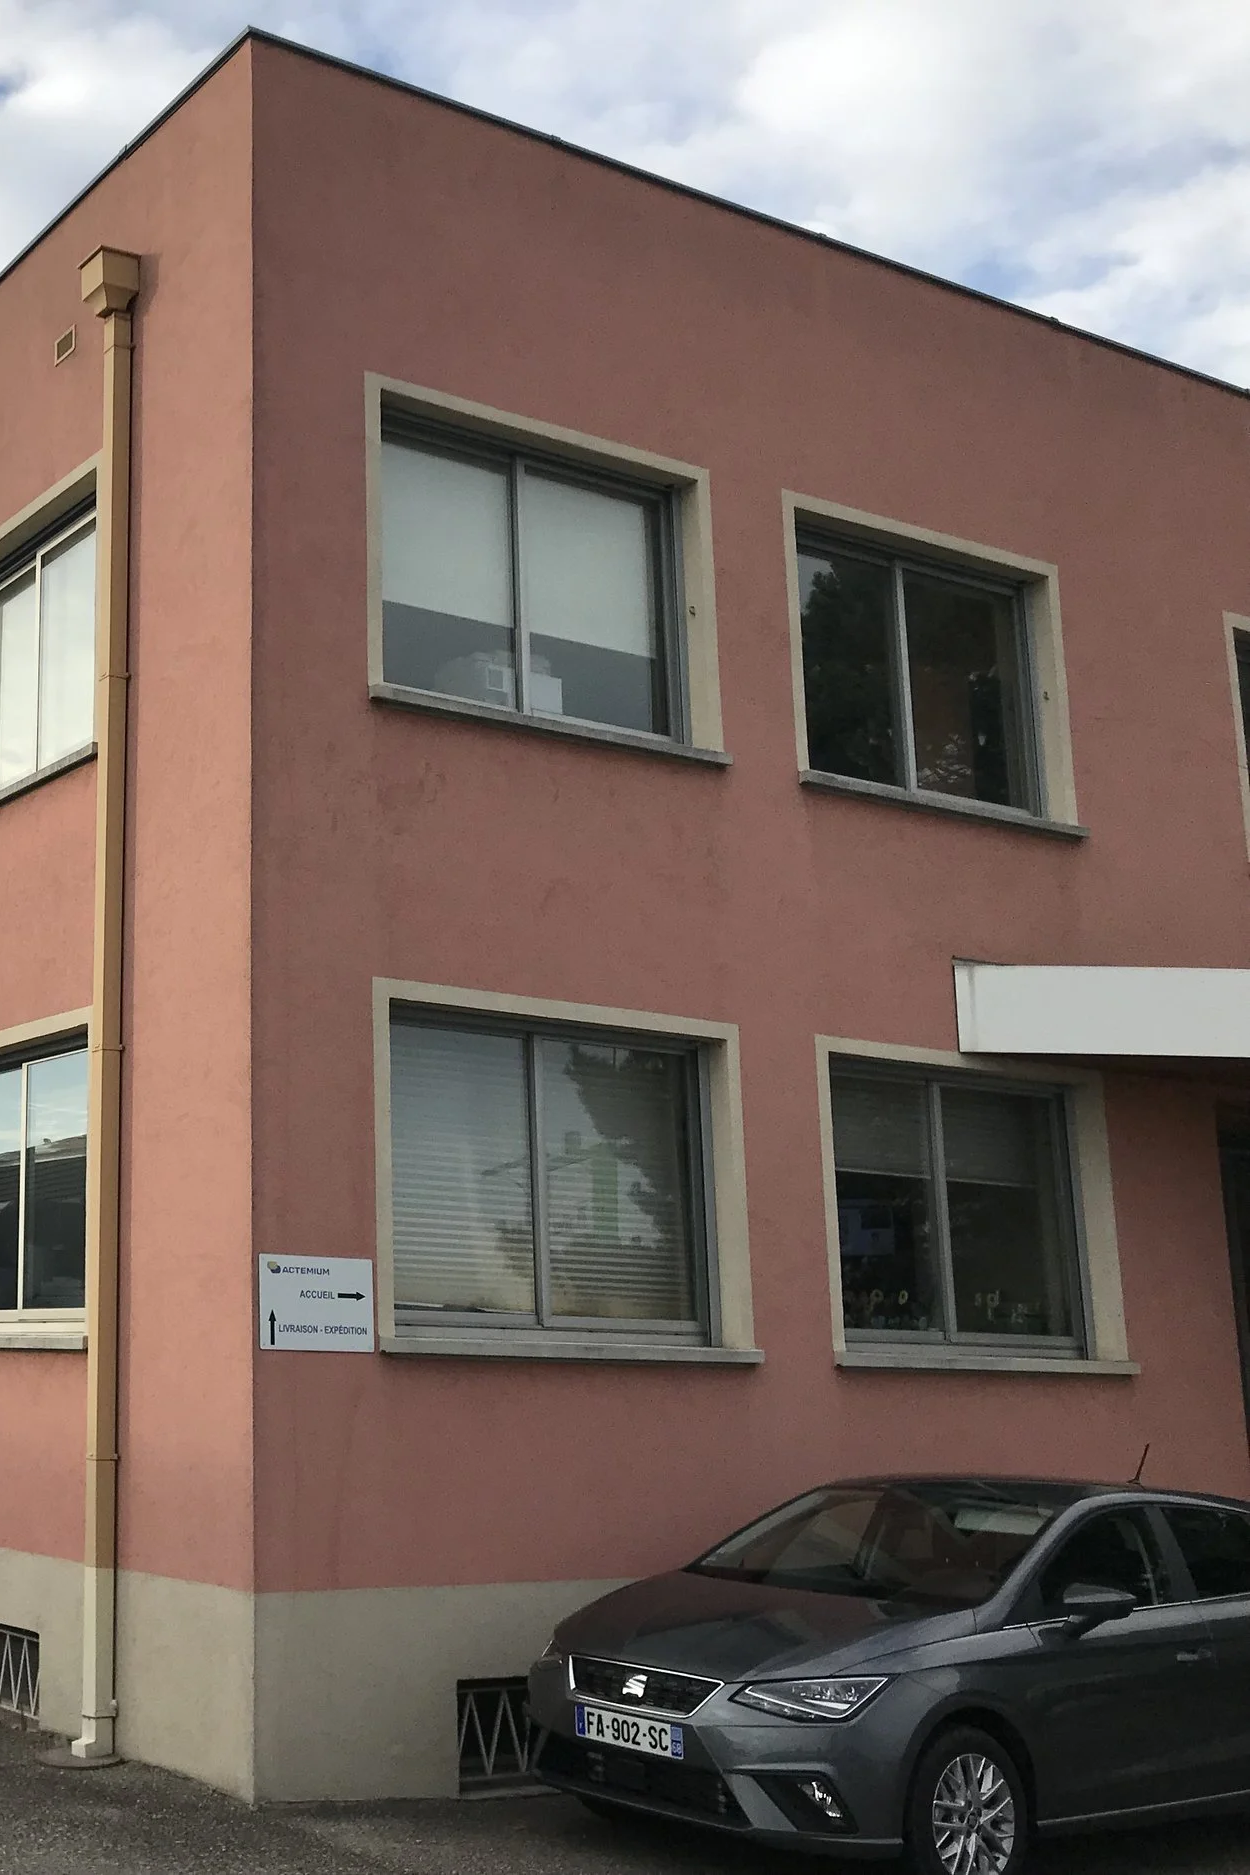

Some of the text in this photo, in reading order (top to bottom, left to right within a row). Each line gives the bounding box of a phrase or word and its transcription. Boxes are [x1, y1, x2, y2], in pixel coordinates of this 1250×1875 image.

[282, 1266, 330, 1276] ACTEMIUM
[299, 1289, 335, 1300] ACCUEIL
[278, 1324, 318, 1334] LIVRAISON
[324, 1324, 367, 1335] EXPÉDITION
[586, 1711, 669, 1752] FA-902-SC
